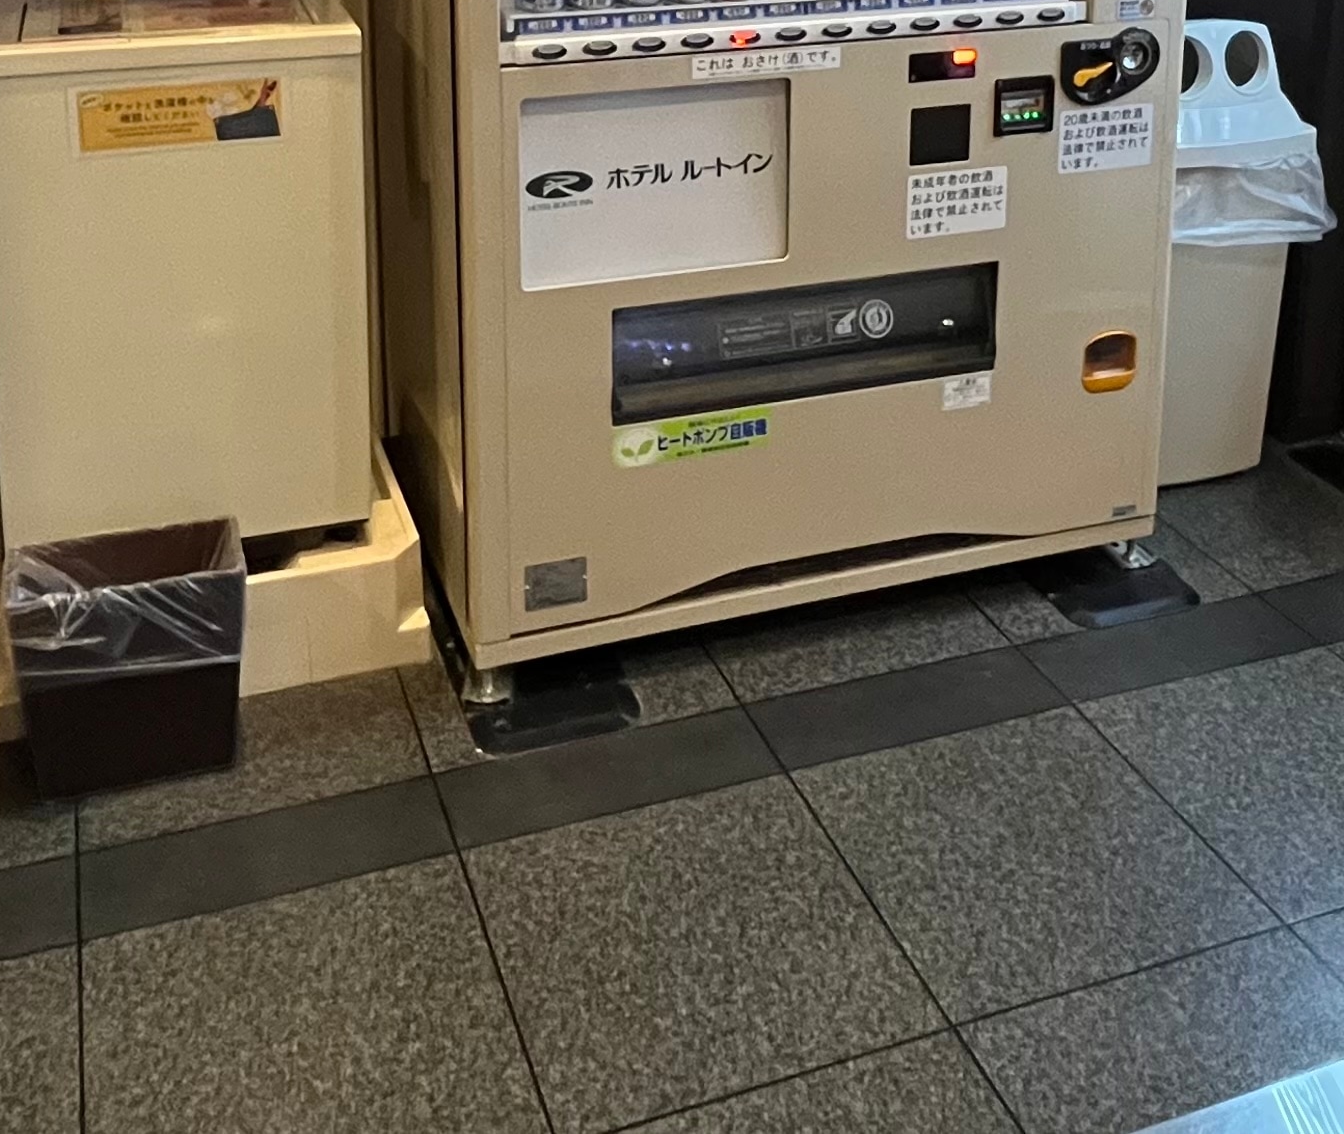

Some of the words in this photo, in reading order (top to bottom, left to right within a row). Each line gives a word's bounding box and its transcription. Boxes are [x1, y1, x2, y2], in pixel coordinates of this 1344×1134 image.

[696, 57, 734, 72] これは
[1063, 107, 1143, 126] 20歳未満の飲酒
[1063, 122, 1149, 141] および飲酒運転は
[606, 163, 673, 190] ホテル
[680, 152, 774, 182] ルートイン
[1061, 156, 1099, 170] います。
[911, 170, 994, 190] 未成年者の飲酒
[911, 185, 1004, 204] および飲酒運転は
[910, 222, 951, 236] います。
